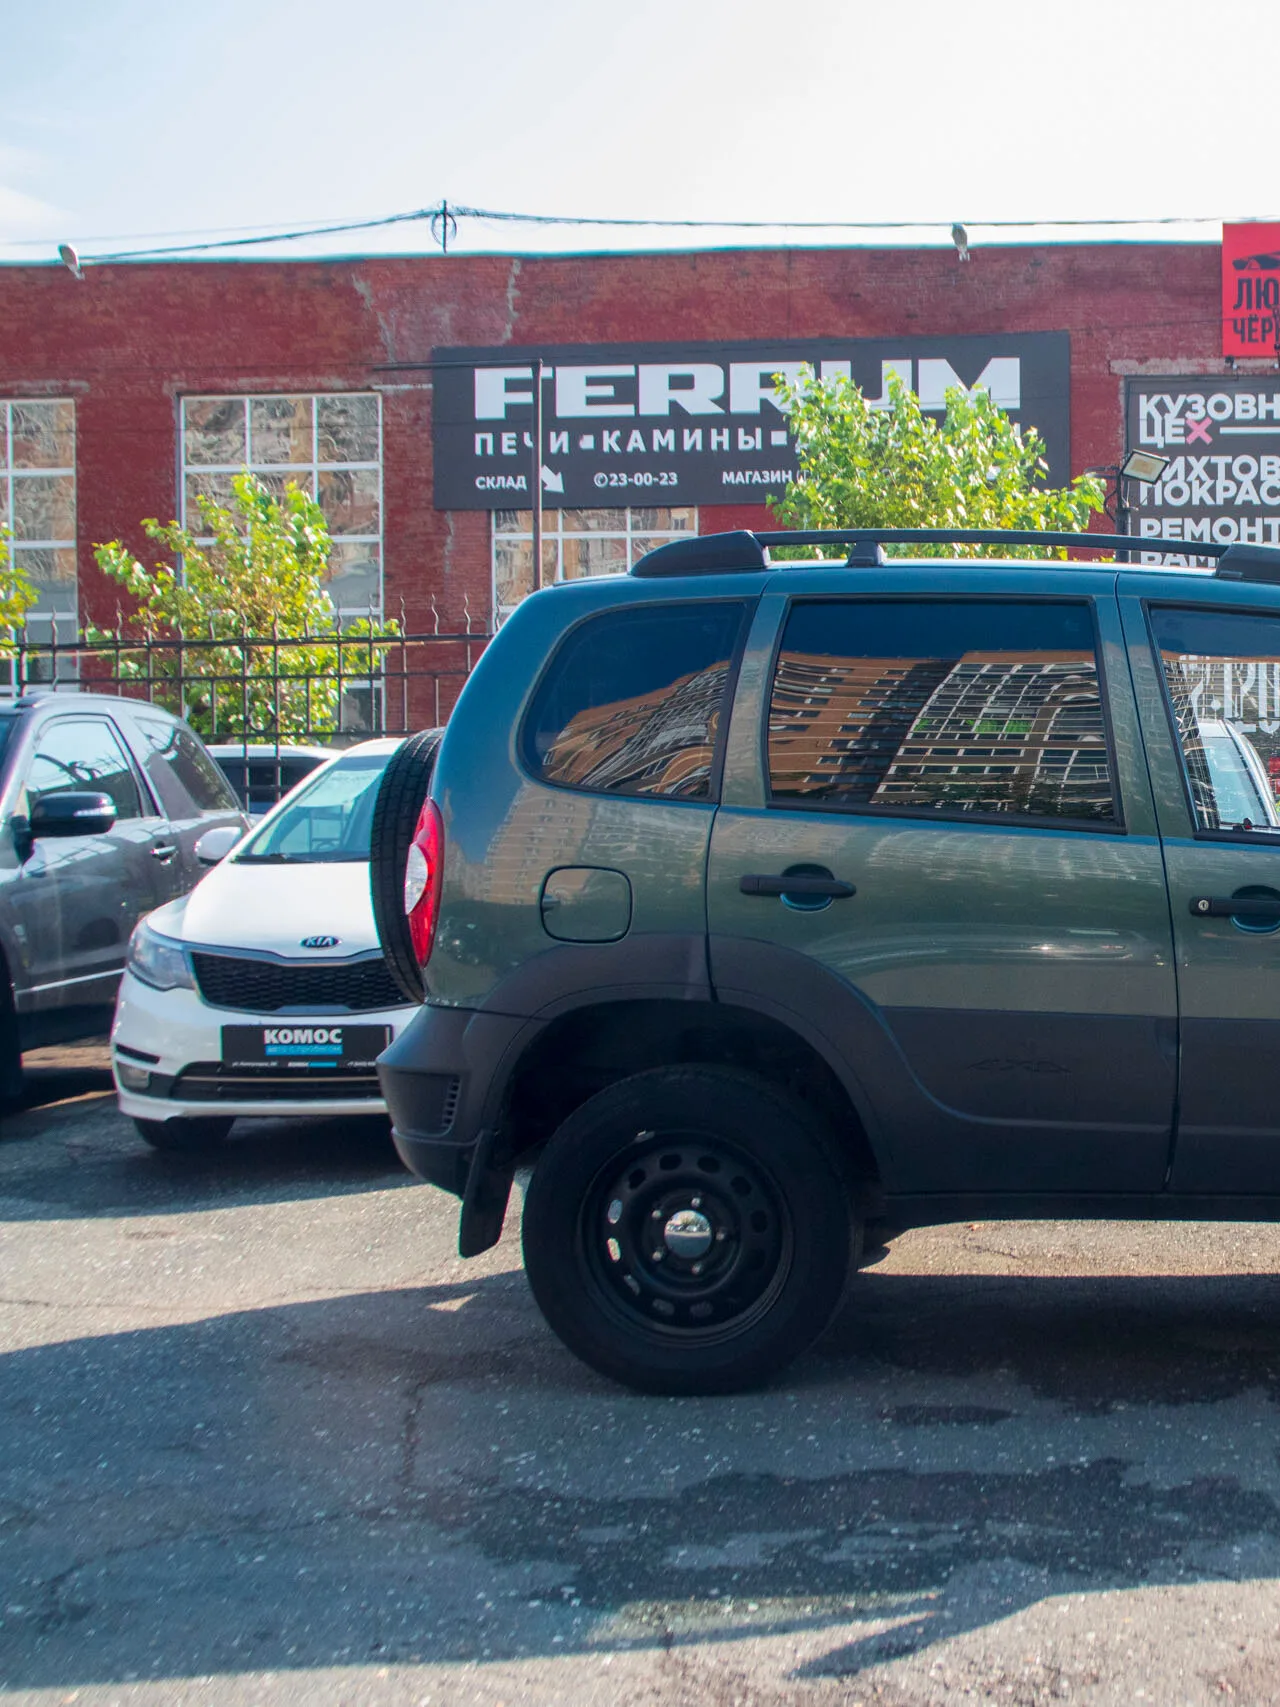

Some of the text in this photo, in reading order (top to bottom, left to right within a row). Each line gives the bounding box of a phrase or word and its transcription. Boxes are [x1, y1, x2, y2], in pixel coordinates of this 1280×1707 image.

[475, 358, 1021, 420] FERRUM
[602, 427, 763, 453] КАМИНЫ
[1139, 417, 1213, 448] ЦЕХ
[475, 475, 527, 491] СКЛАД
[722, 470, 792, 484] МАГАЗИН
[1140, 517, 1280, 543] РЕМОНТ
[304, 936, 334, 947] KIA
[264, 1029, 342, 1044] КОМОС
